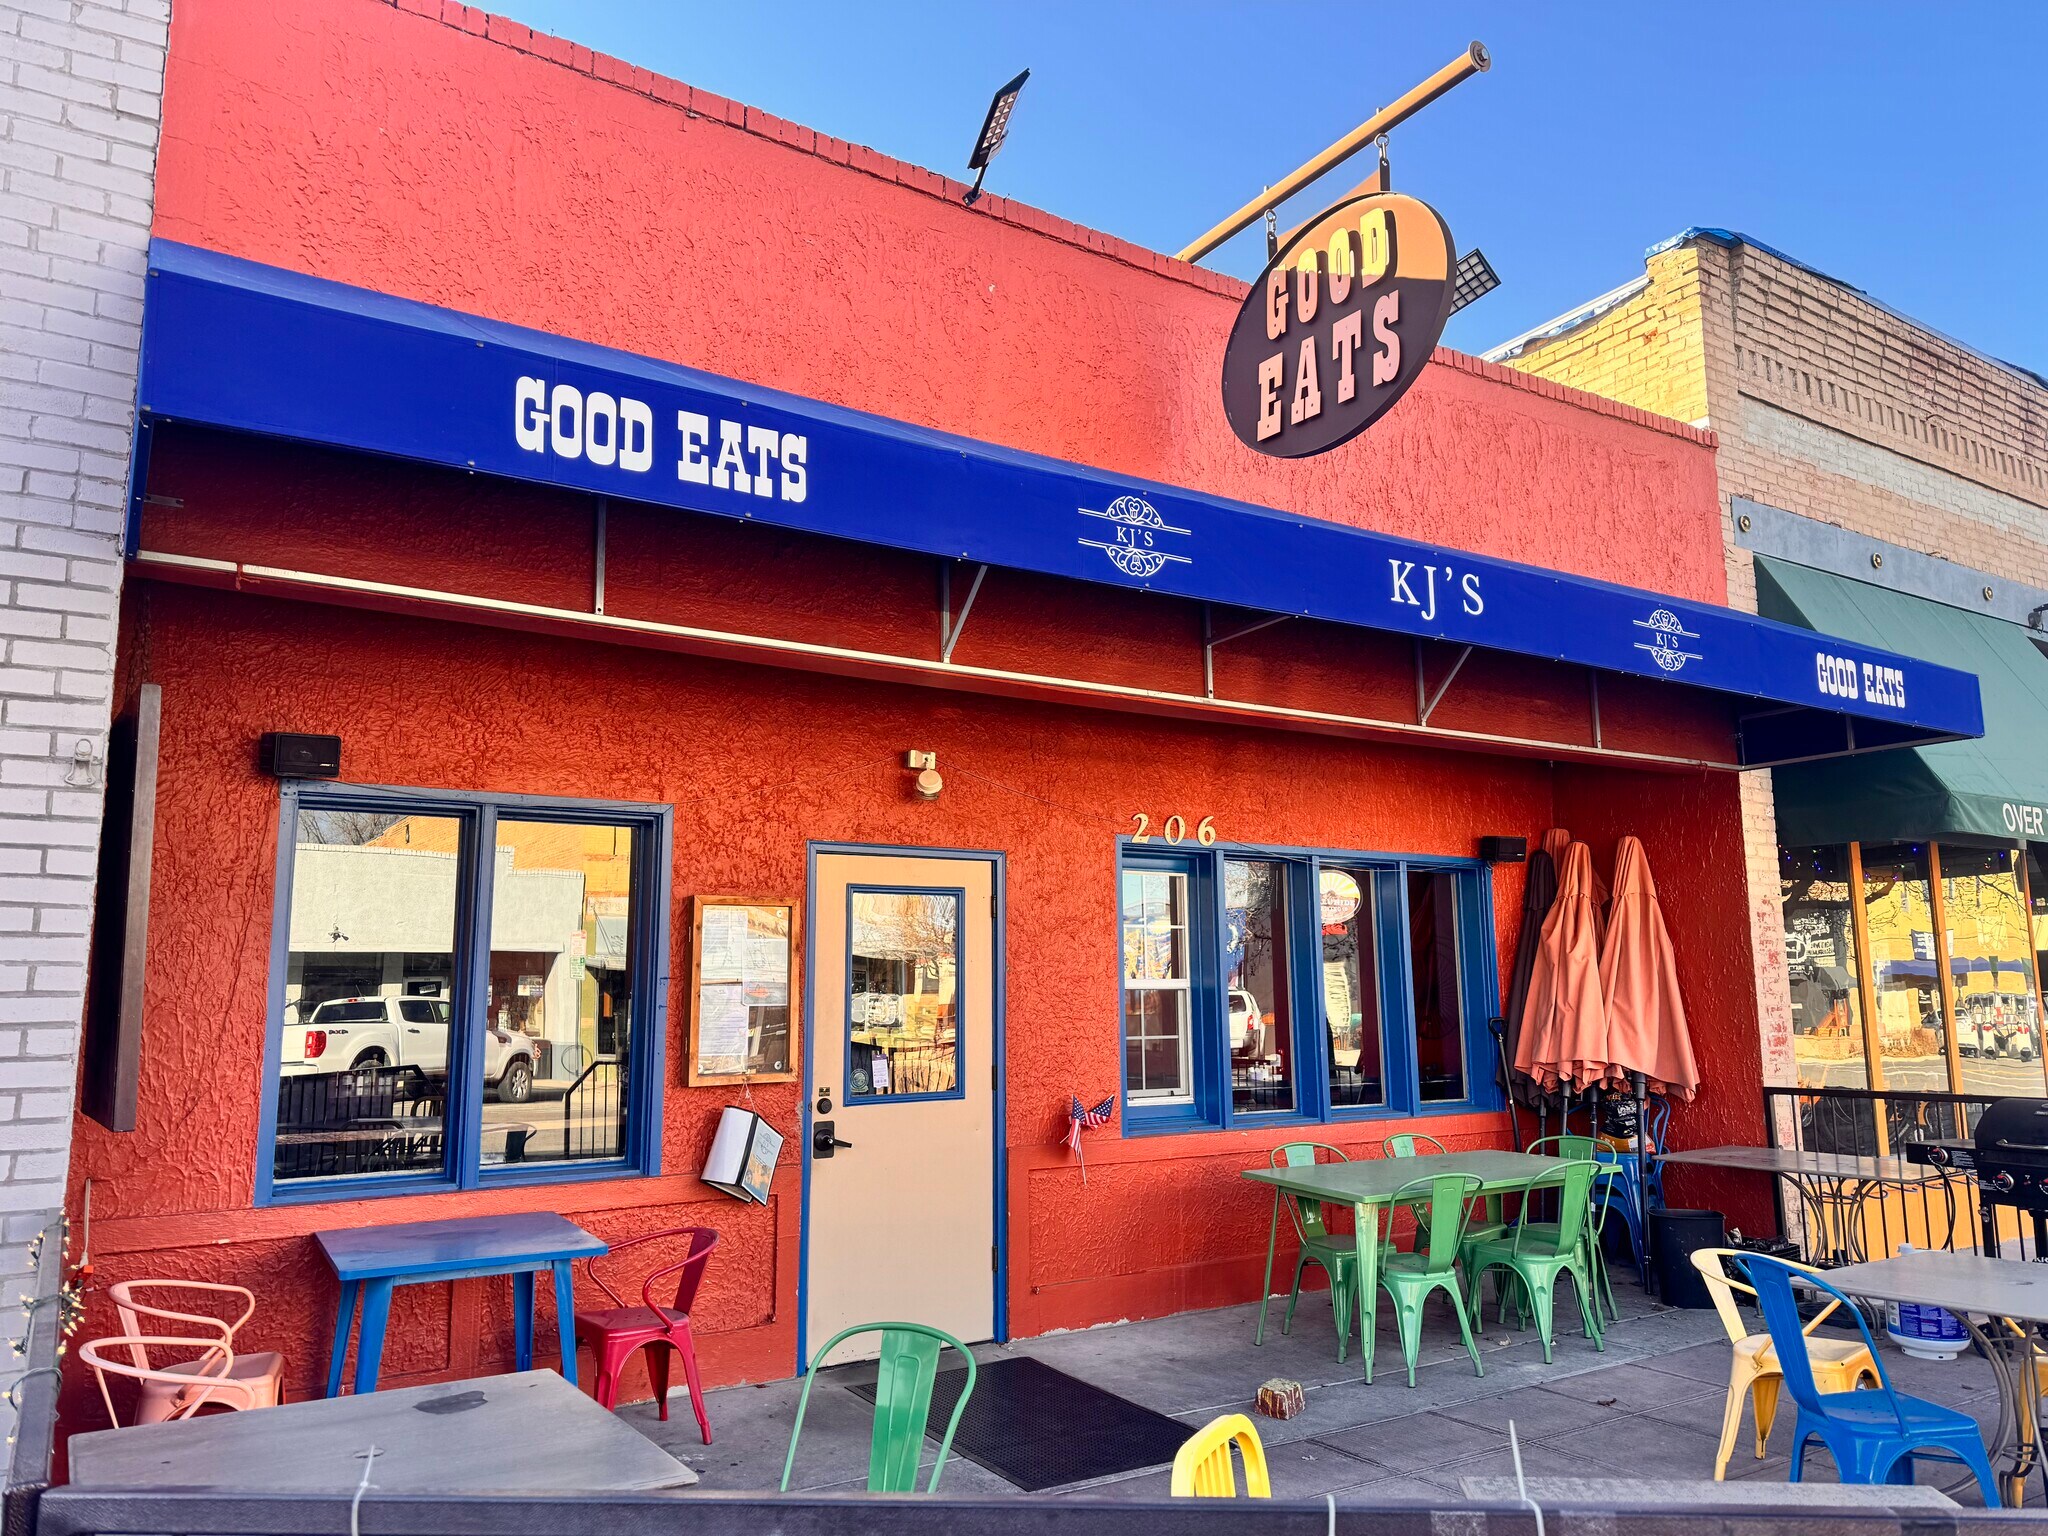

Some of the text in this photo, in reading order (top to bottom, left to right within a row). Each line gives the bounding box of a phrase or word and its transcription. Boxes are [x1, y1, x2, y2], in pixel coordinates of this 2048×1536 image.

[1266, 207, 1390, 341] GOOD
[1256, 289, 1400, 442] EATS
[515, 376, 807, 503] GOOD EATS
[1116, 525, 1154, 548] KJ'S
[1388, 559, 1484, 621] KJ'S
[1655, 632, 1679, 649] KJ'S
[1816, 652, 1905, 708] GOOD EATS
[1131, 812, 1216, 847] 206
[2002, 802, 2045, 836] OVER
